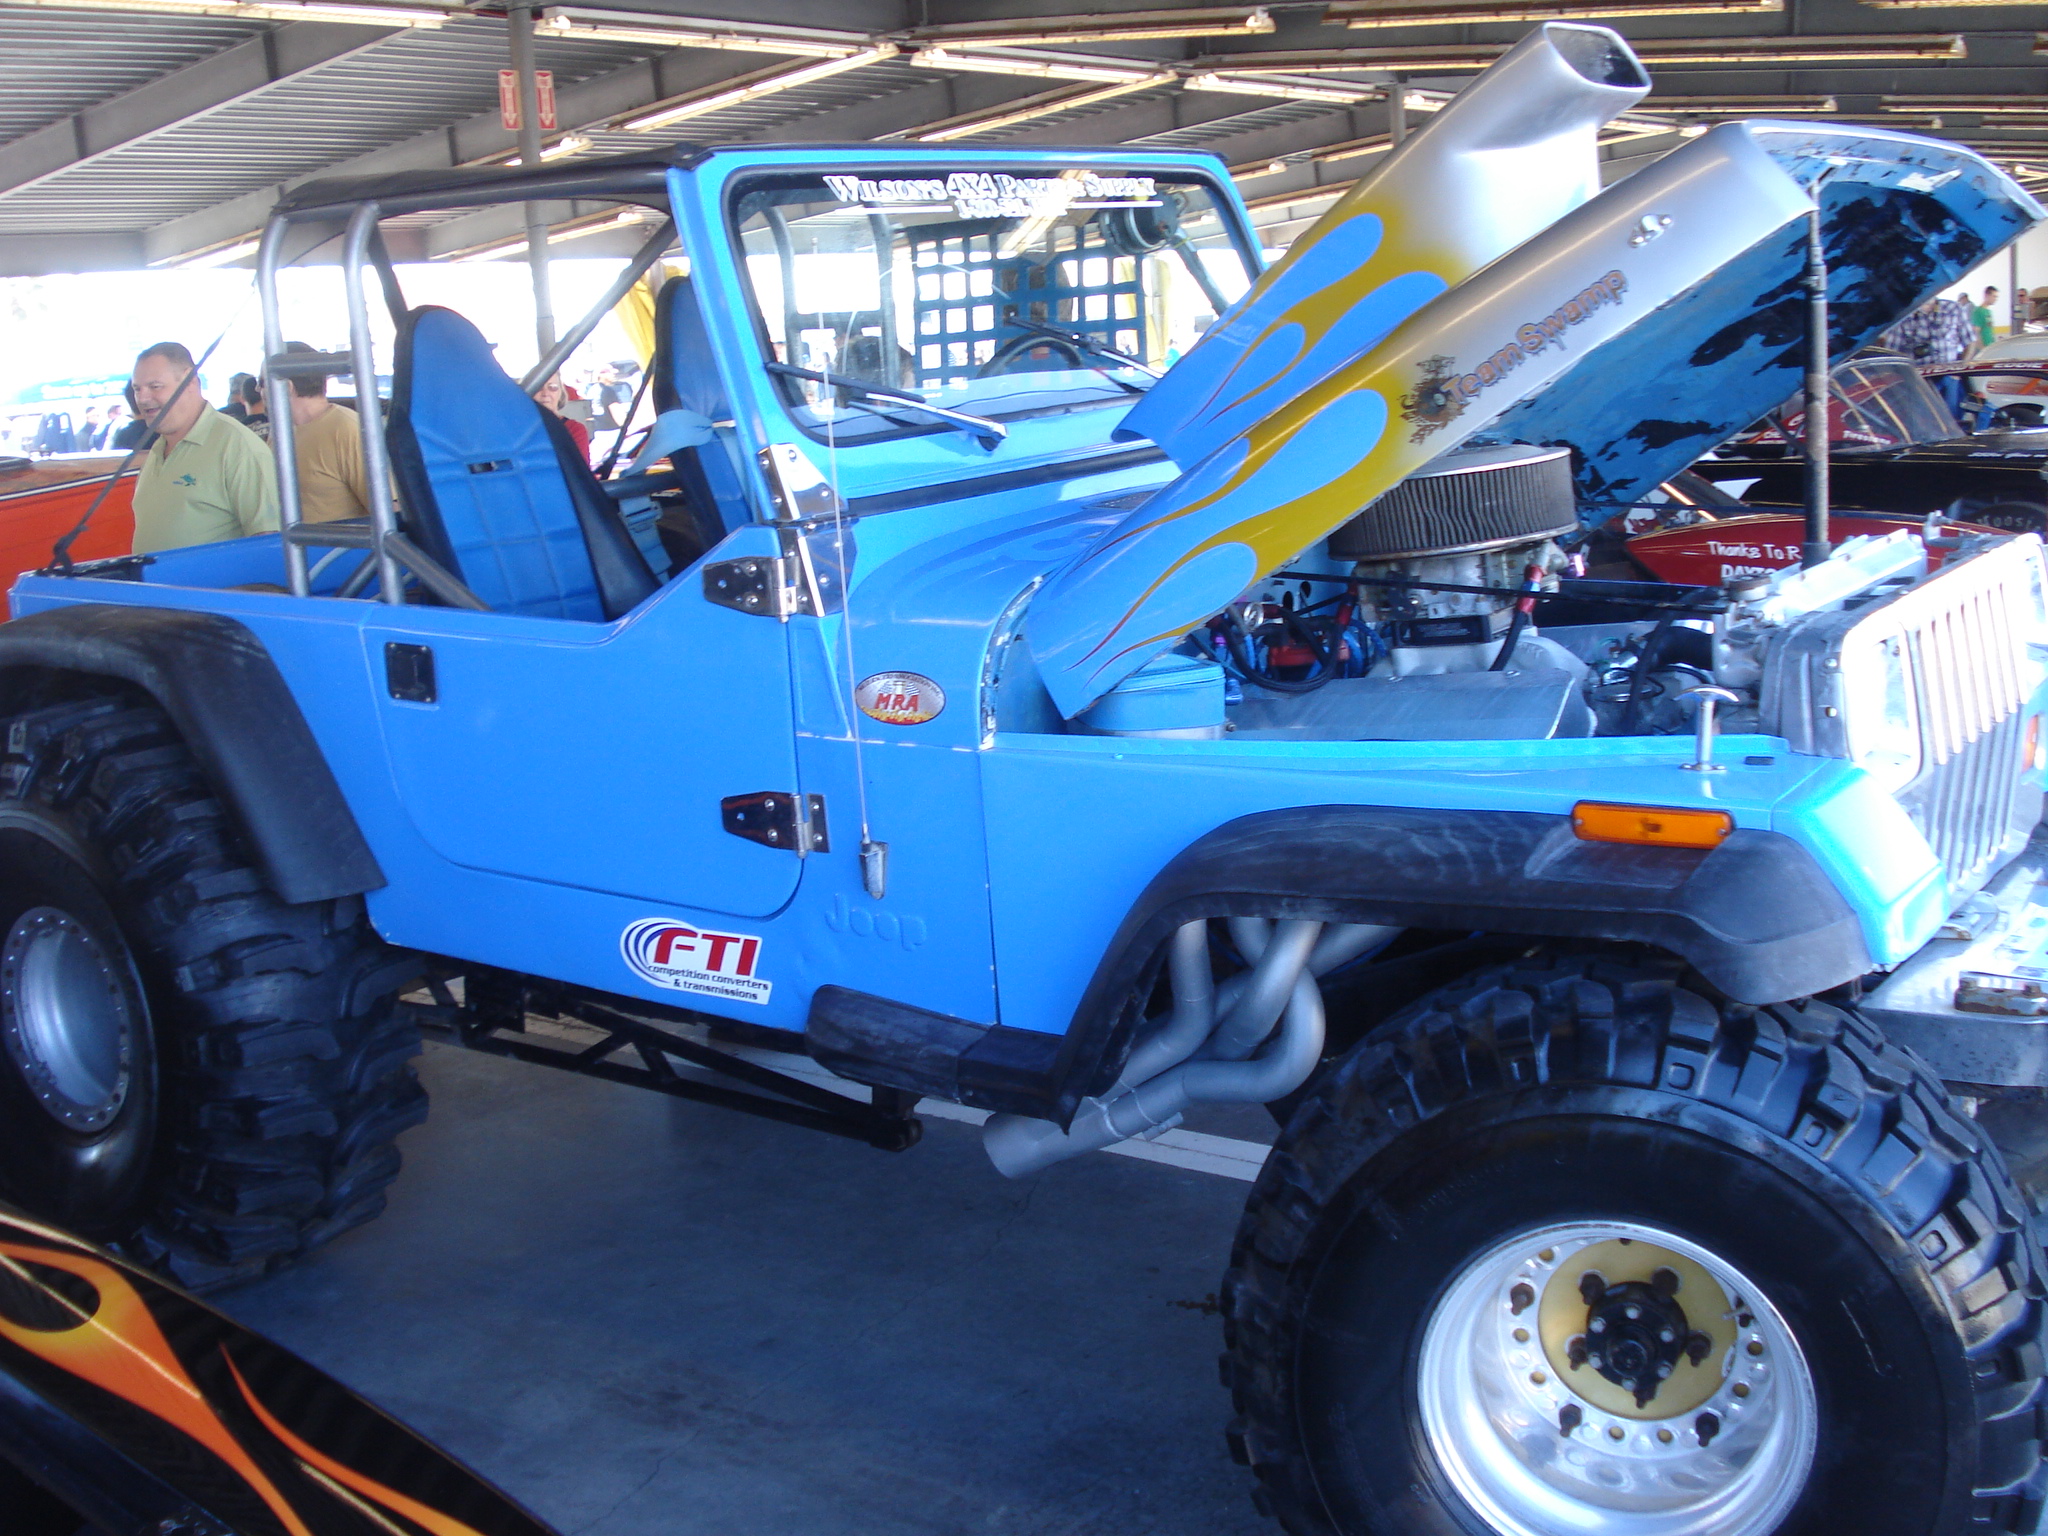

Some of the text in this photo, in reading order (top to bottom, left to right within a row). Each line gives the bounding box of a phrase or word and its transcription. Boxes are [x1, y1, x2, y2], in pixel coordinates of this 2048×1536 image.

[1440, 269, 1628, 404] Team Swamp
[1706, 541, 1762, 559] Thanks
[1762, 543, 1784, 560] To
[874, 693, 919, 712] MRA
[824, 892, 928, 952] Jeep
[653, 928, 758, 976] FTI
[648, 964, 769, 991] competition converters
[673, 978, 758, 1001] & transmissions
